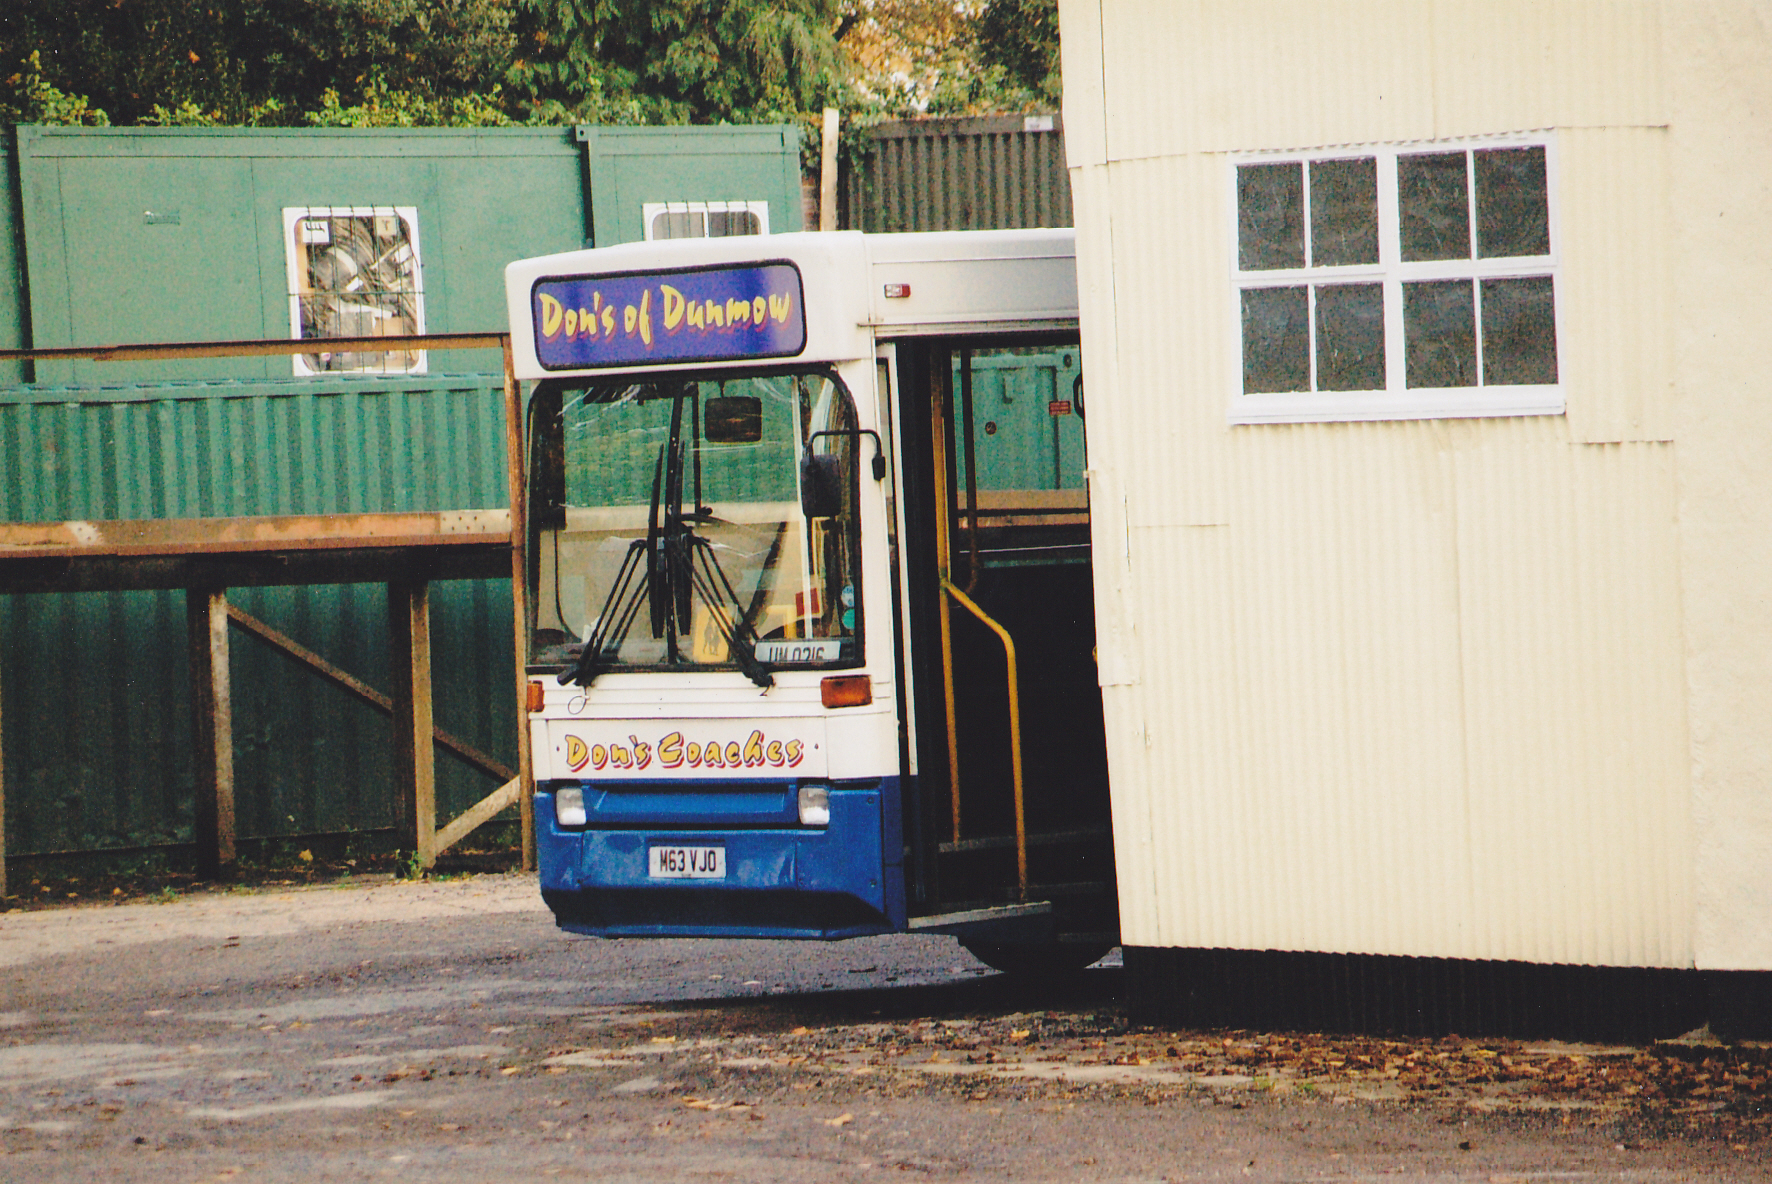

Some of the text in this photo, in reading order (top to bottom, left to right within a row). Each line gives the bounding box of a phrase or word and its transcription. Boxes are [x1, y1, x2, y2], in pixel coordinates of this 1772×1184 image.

[539, 285, 791, 346] Don's of Dunmow
[565, 730, 804, 772] Don's Coaches
[660, 849, 686, 872] M63
